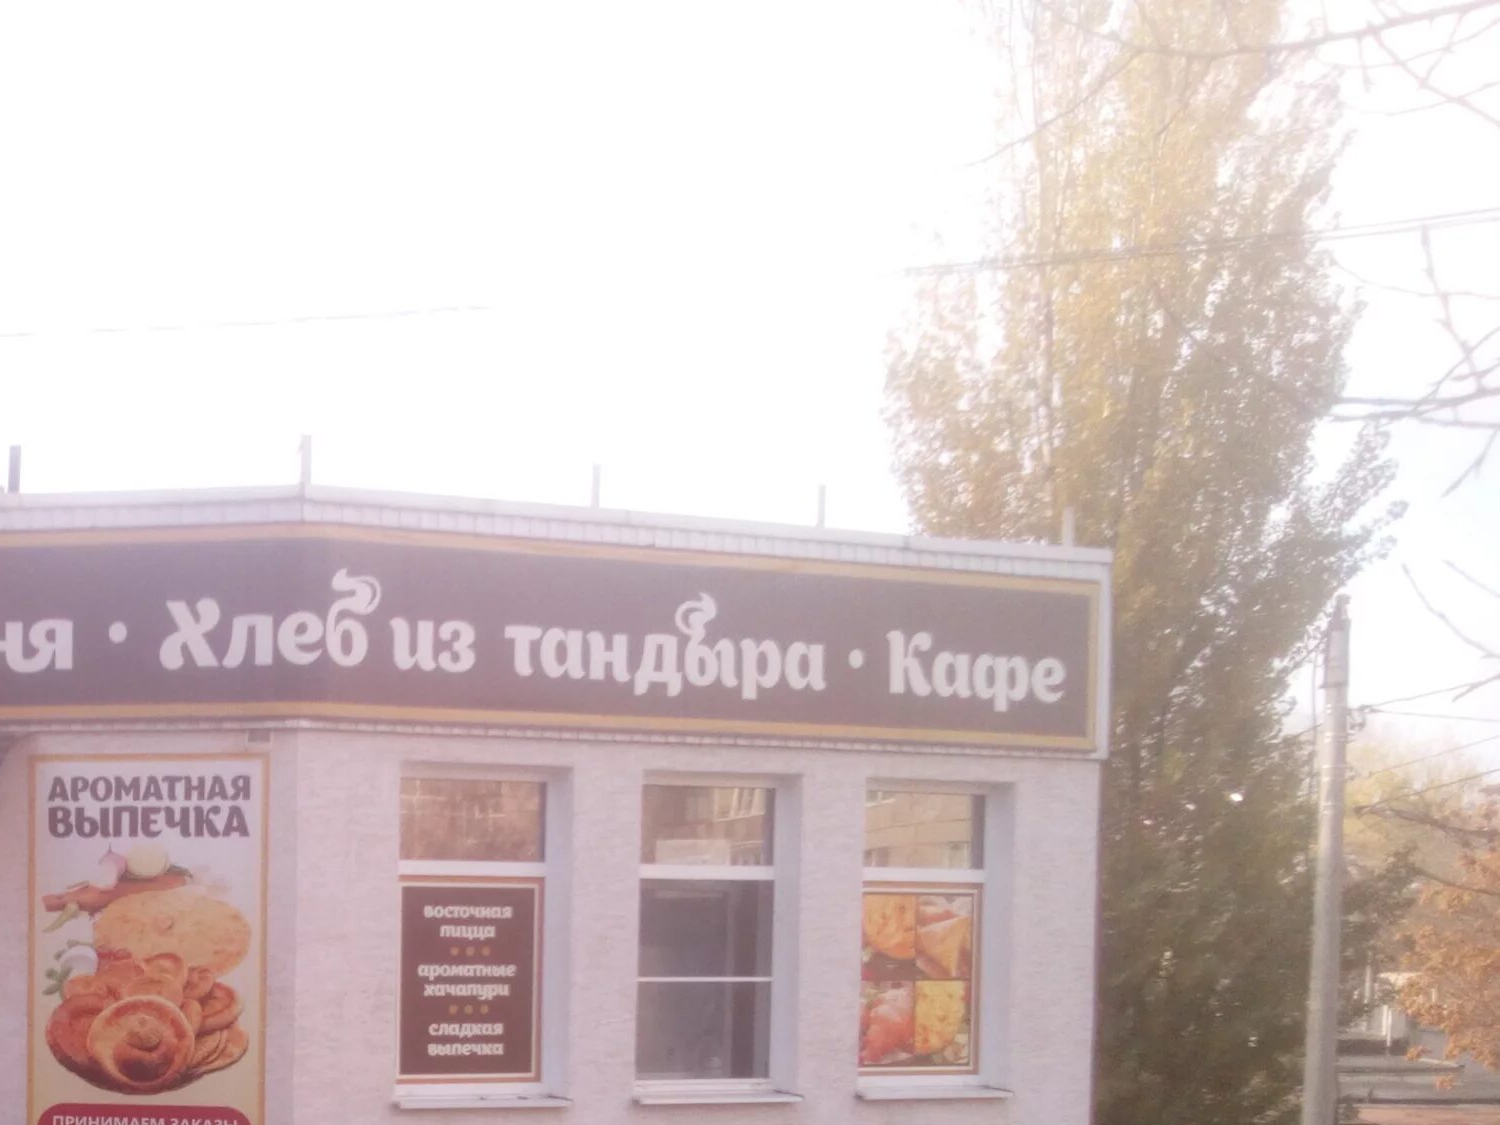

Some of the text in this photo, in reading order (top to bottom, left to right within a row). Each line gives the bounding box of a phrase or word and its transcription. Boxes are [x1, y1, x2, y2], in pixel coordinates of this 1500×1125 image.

[159, 569, 381, 669] Хлеб
[391, 616, 476, 673] из
[504, 592, 826, 700] тандыра
[886, 630, 1066, 712] Кафе
[47, 775, 252, 803] АРОМАТНАЯ
[47, 804, 250, 839] ВЫПЕЧКА
[423, 905, 513, 919] восточная
[439, 924, 496, 940] пицца
[417, 964, 516, 980] ароматные
[424, 984, 510, 1000] хачапури
[428, 1022, 503, 1038] сладкая
[428, 1043, 504, 1056] выпечка
